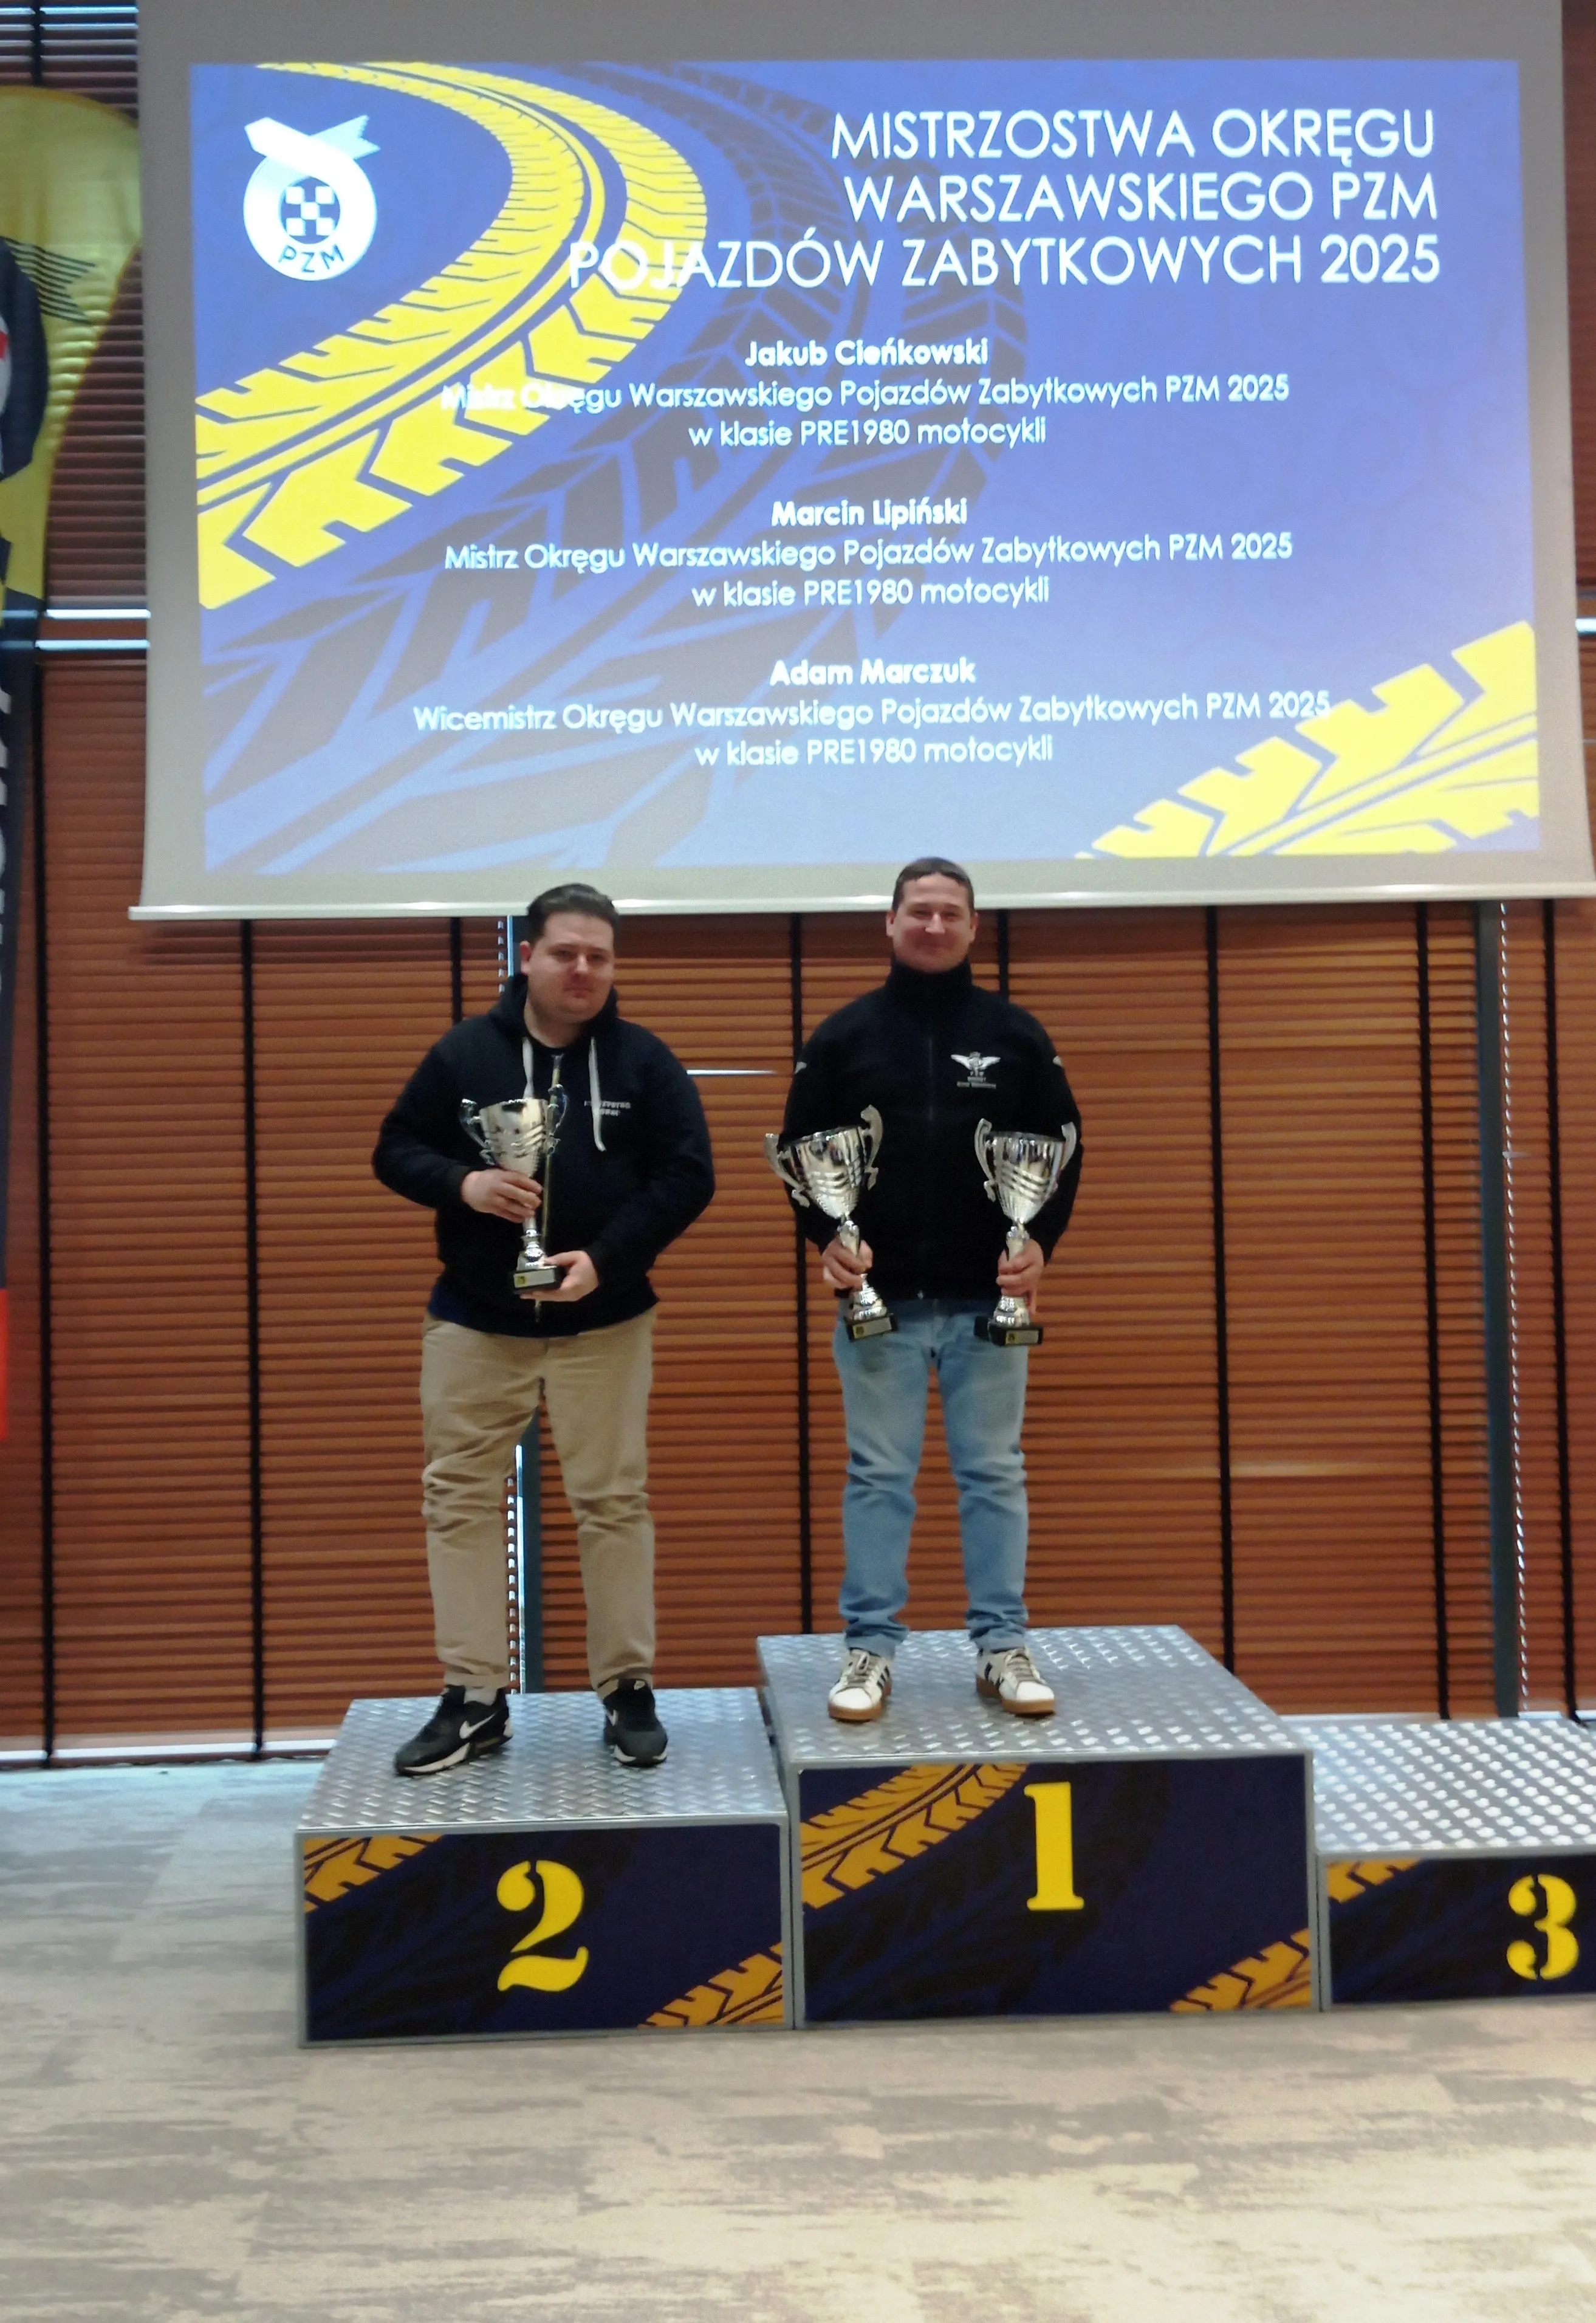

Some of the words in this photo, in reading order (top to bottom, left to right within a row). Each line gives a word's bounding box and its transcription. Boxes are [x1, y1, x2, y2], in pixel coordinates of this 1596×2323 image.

[832, 109, 1196, 159] MISTRZOSTWA
[1212, 108, 1434, 168] OKRĘGU
[843, 171, 1313, 222] WARSZAWSKIEGO
[1332, 171, 1437, 220] PZM
[278, 244, 345, 273] PZM
[569, 227, 884, 289] POJAZDÓW
[902, 234, 1301, 286] ZABYTKOWYCH
[1320, 233, 1440, 283] 2025
[744, 340, 828, 366] Jakub
[835, 337, 988, 366] Cieńkowski
[629, 380, 833, 412] Warszawskiego
[840, 378, 972, 412] Pojazdów
[978, 375, 1157, 410] Zabytkowych
[1166, 374, 1220, 402] PZM
[1227, 373, 1289, 402] 2025
[688, 427, 714, 447] w
[720, 420, 793, 447] klasie
[801, 419, 910, 445] PRE1980
[917, 416, 1046, 449] motocykli
[771, 499, 865, 526] Marcin
[872, 496, 967, 531] Lipiński
[445, 544, 519, 569] Mistrz
[524, 543, 626, 574] Okręgu
[632, 540, 836, 572] Warszawskiego
[844, 537, 975, 571] Pojazdów
[981, 534, 1160, 569] Zabytkowych
[1169, 533, 1223, 560] PZM
[1231, 532, 1292, 560] 2025
[691, 588, 717, 606] w
[724, 580, 796, 607] klasie
[804, 578, 914, 606] PRE1980
[920, 575, 1049, 609] motocykli
[769, 659, 854, 686] Adam
[860, 656, 977, 685] Marczuk
[413, 704, 557, 731] Wicemistrz
[562, 703, 663, 734] Okręgu
[670, 699, 874, 731] Warszawskiego
[882, 696, 1012, 730] Pojazdów
[1019, 692, 1198, 727] Zabytkowych
[1206, 691, 1261, 719] PZM
[1268, 690, 1331, 719] 2025
[694, 747, 720, 766] w
[727, 739, 800, 766] klasie
[807, 737, 917, 765] PRE1980
[923, 733, 1053, 767] motocykli
[1024, 1781, 1084, 1910] 1
[498, 1862, 587, 1991] 2
[1507, 1876, 1578, 1978] 3
